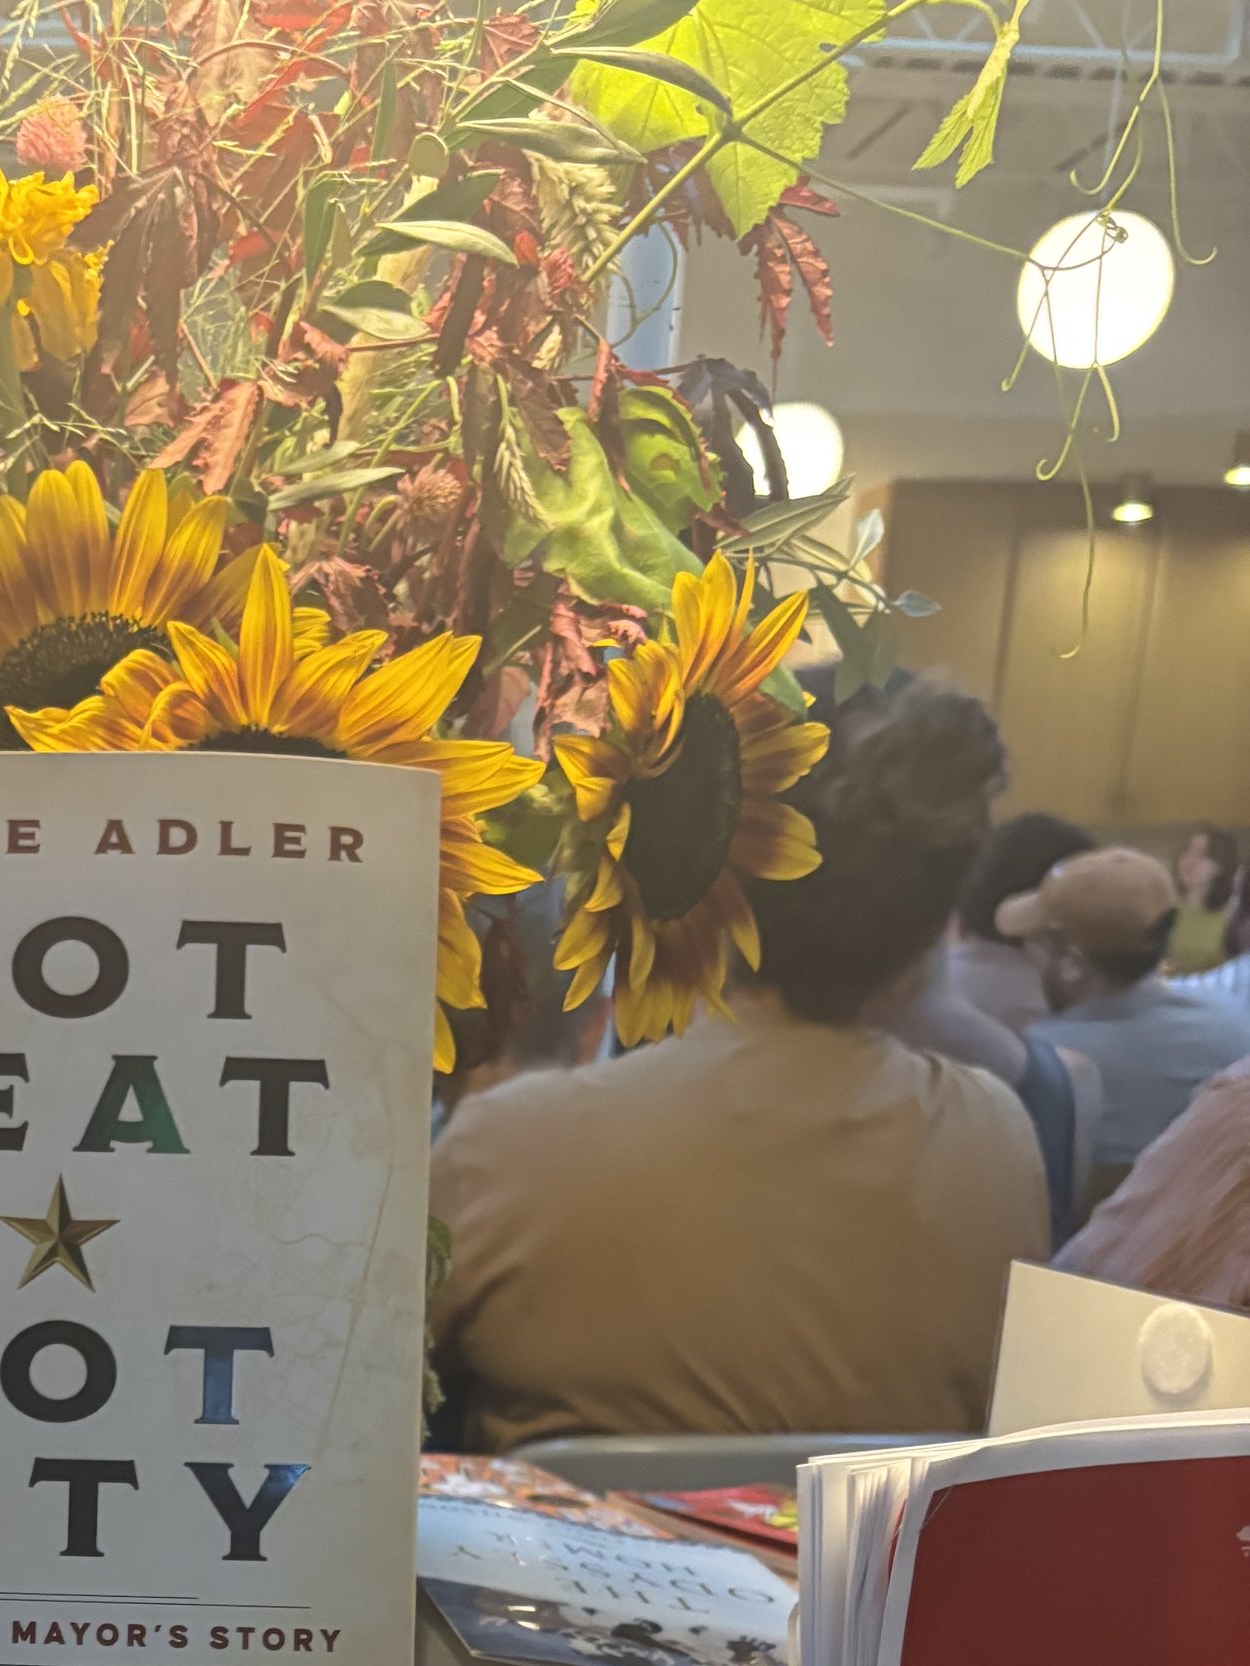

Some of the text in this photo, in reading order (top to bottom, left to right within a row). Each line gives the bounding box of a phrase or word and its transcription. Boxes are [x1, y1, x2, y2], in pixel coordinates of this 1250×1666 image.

[95, 819, 364, 863] ADLER
[12, 1620, 189, 1649] MAYOR'S
[208, 1626, 343, 1653] STORY
